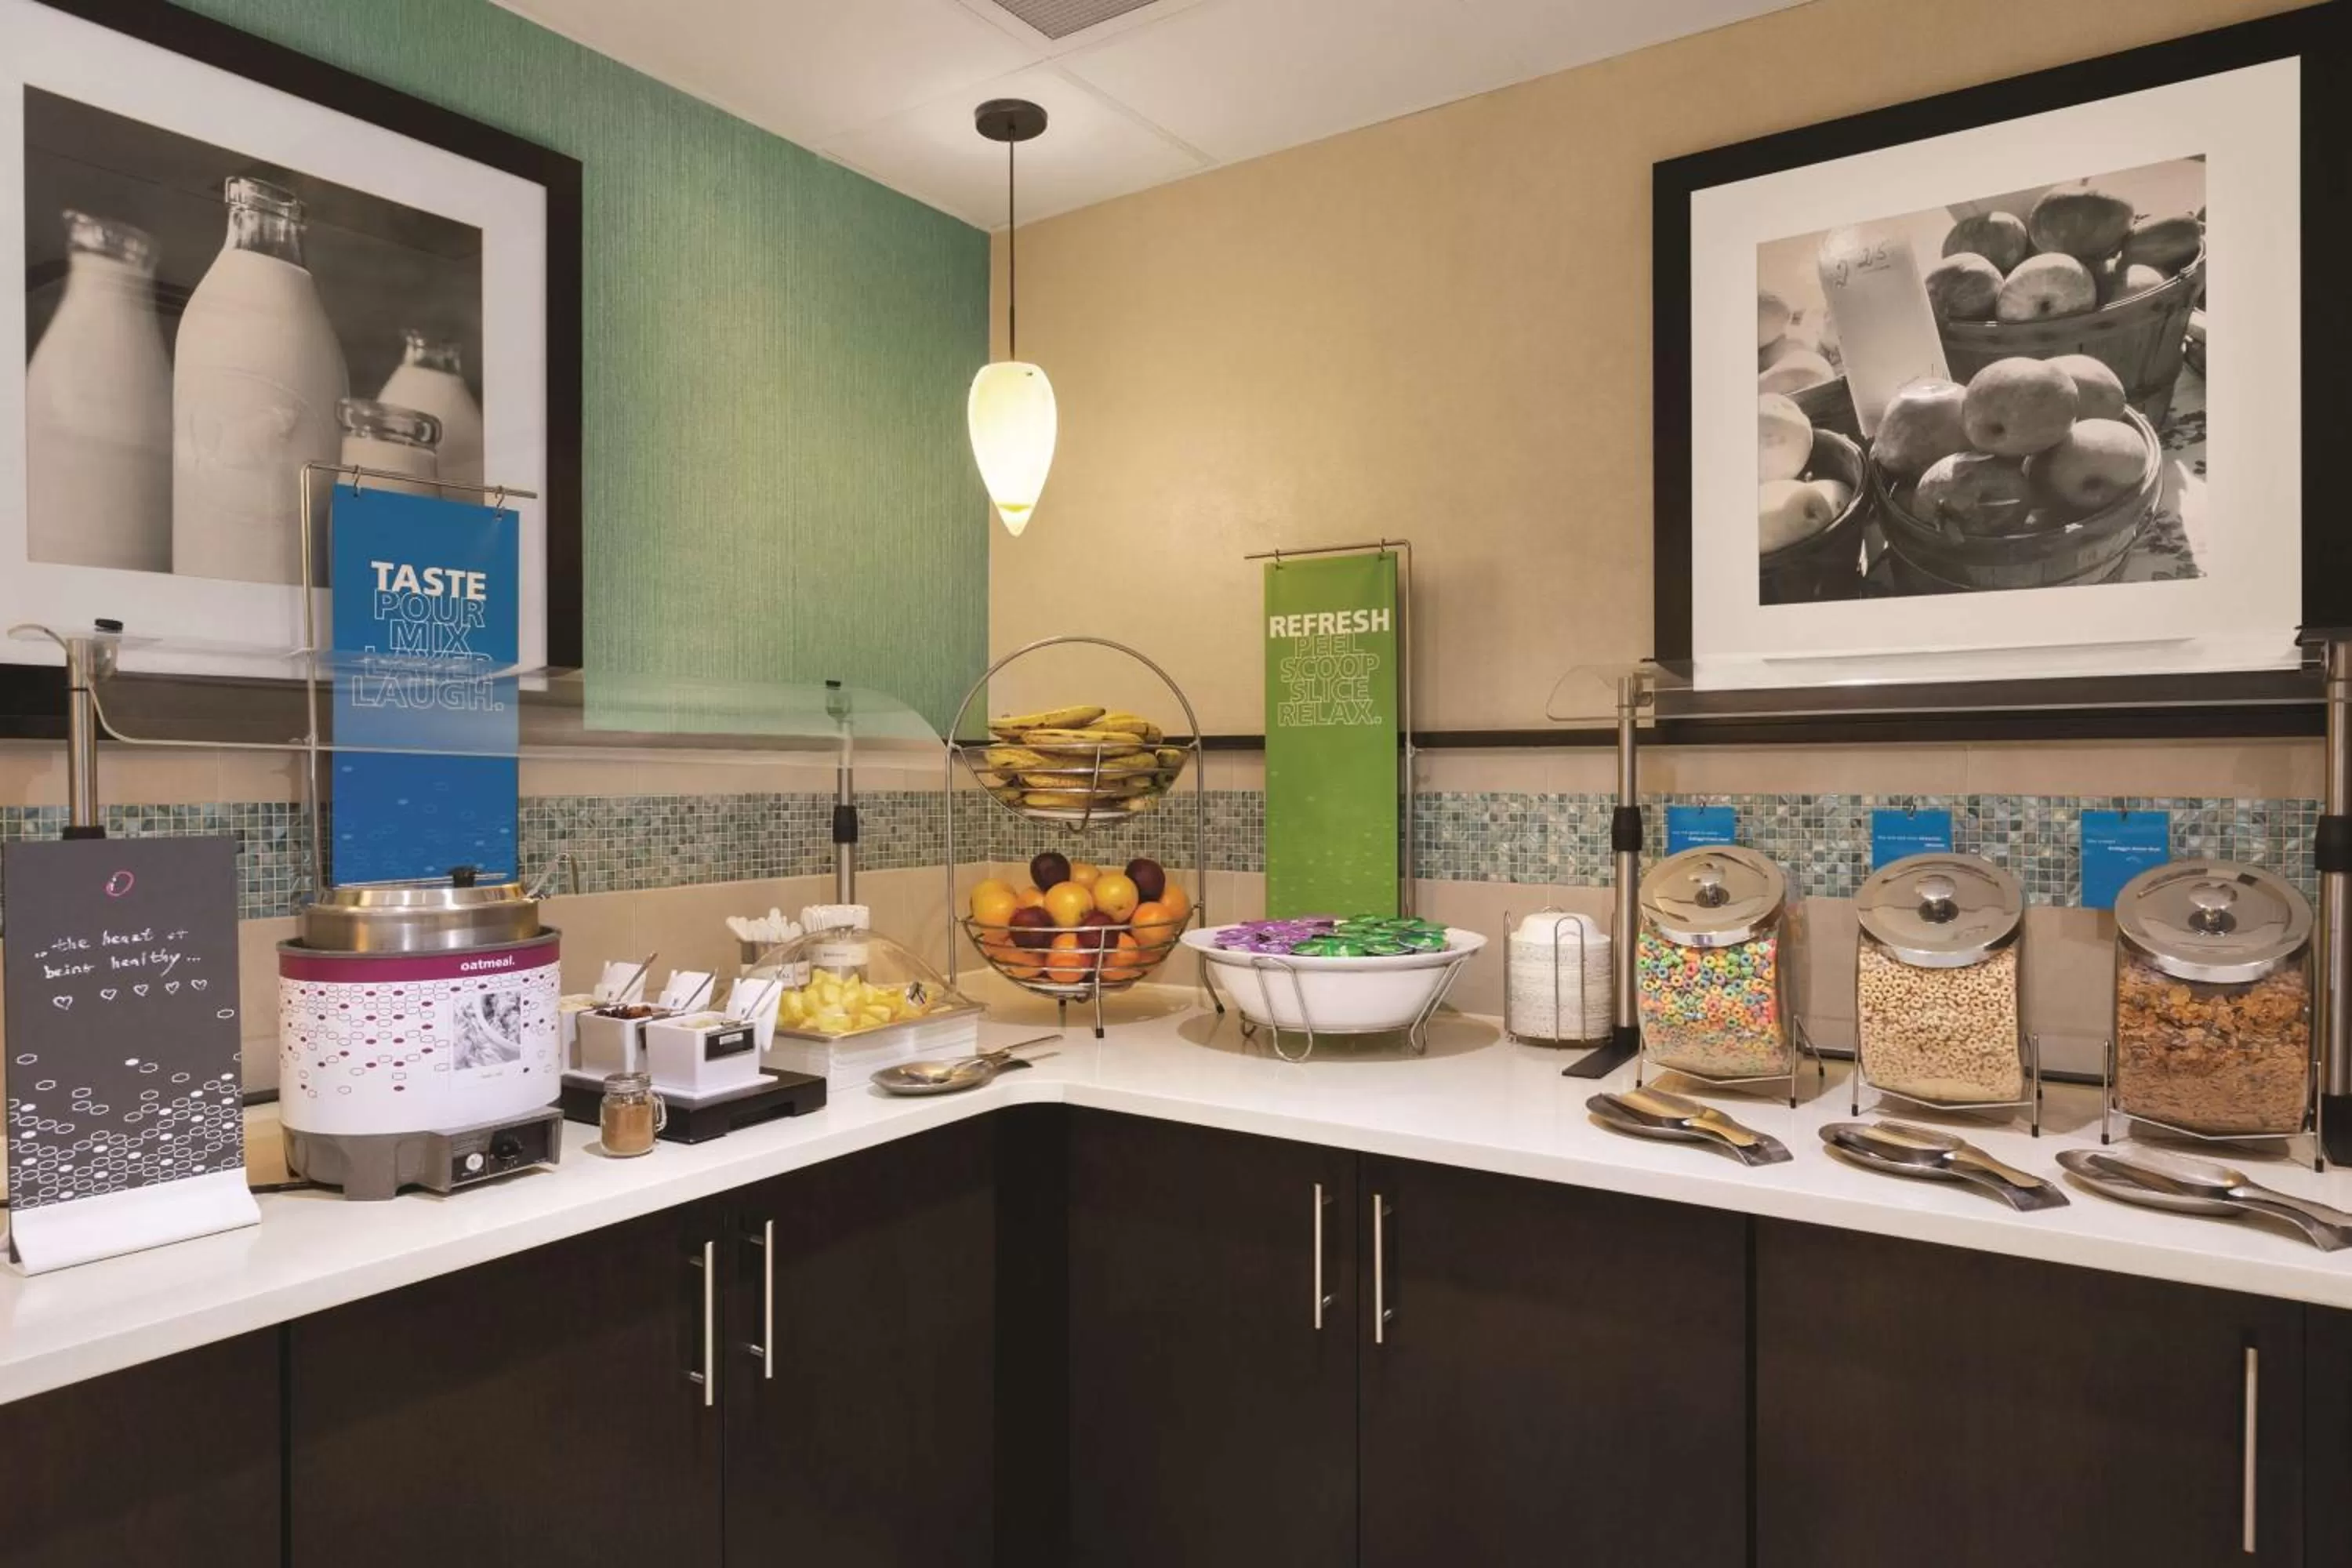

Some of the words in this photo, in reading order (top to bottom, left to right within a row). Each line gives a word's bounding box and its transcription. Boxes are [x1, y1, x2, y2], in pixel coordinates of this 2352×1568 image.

[371, 561, 487, 601] TASTE
[374, 590, 485, 628] POUR
[1269, 608, 1390, 638] REFRESH
[390, 619, 471, 652] MIX
[1294, 633, 1365, 659] PEEL
[1280, 653, 1381, 683] SCOOP
[351, 675, 504, 712] LAUGH.
[1290, 677, 1370, 703] SLICE
[1277, 699, 1382, 727] RELAX.
[102, 927, 154, 946] heart
[460, 954, 515, 971] oatmeal.
